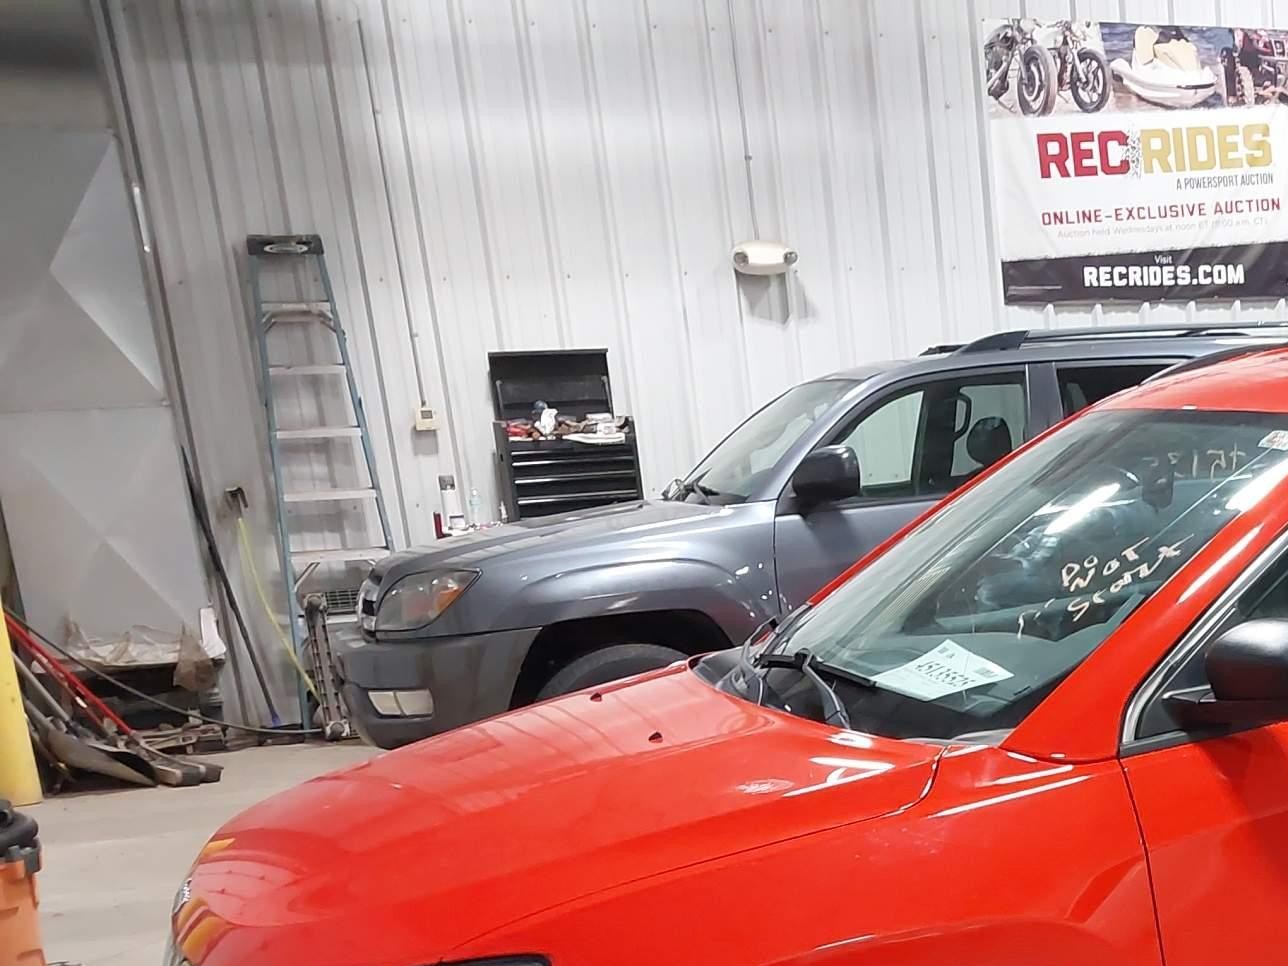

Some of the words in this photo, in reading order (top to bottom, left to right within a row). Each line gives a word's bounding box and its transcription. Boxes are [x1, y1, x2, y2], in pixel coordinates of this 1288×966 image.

[1176, 178, 1182, 190] A
[1184, 175, 1239, 190] POWERSPORT
[1240, 173, 1274, 187] AUCTION
[1041, 203, 1206, 226] ONLINE-EXCLUSIVE
[1214, 197, 1281, 215] AUCTION
[1154, 255, 1173, 264] Visit
[1083, 263, 1245, 287] RECRIDES.COM
